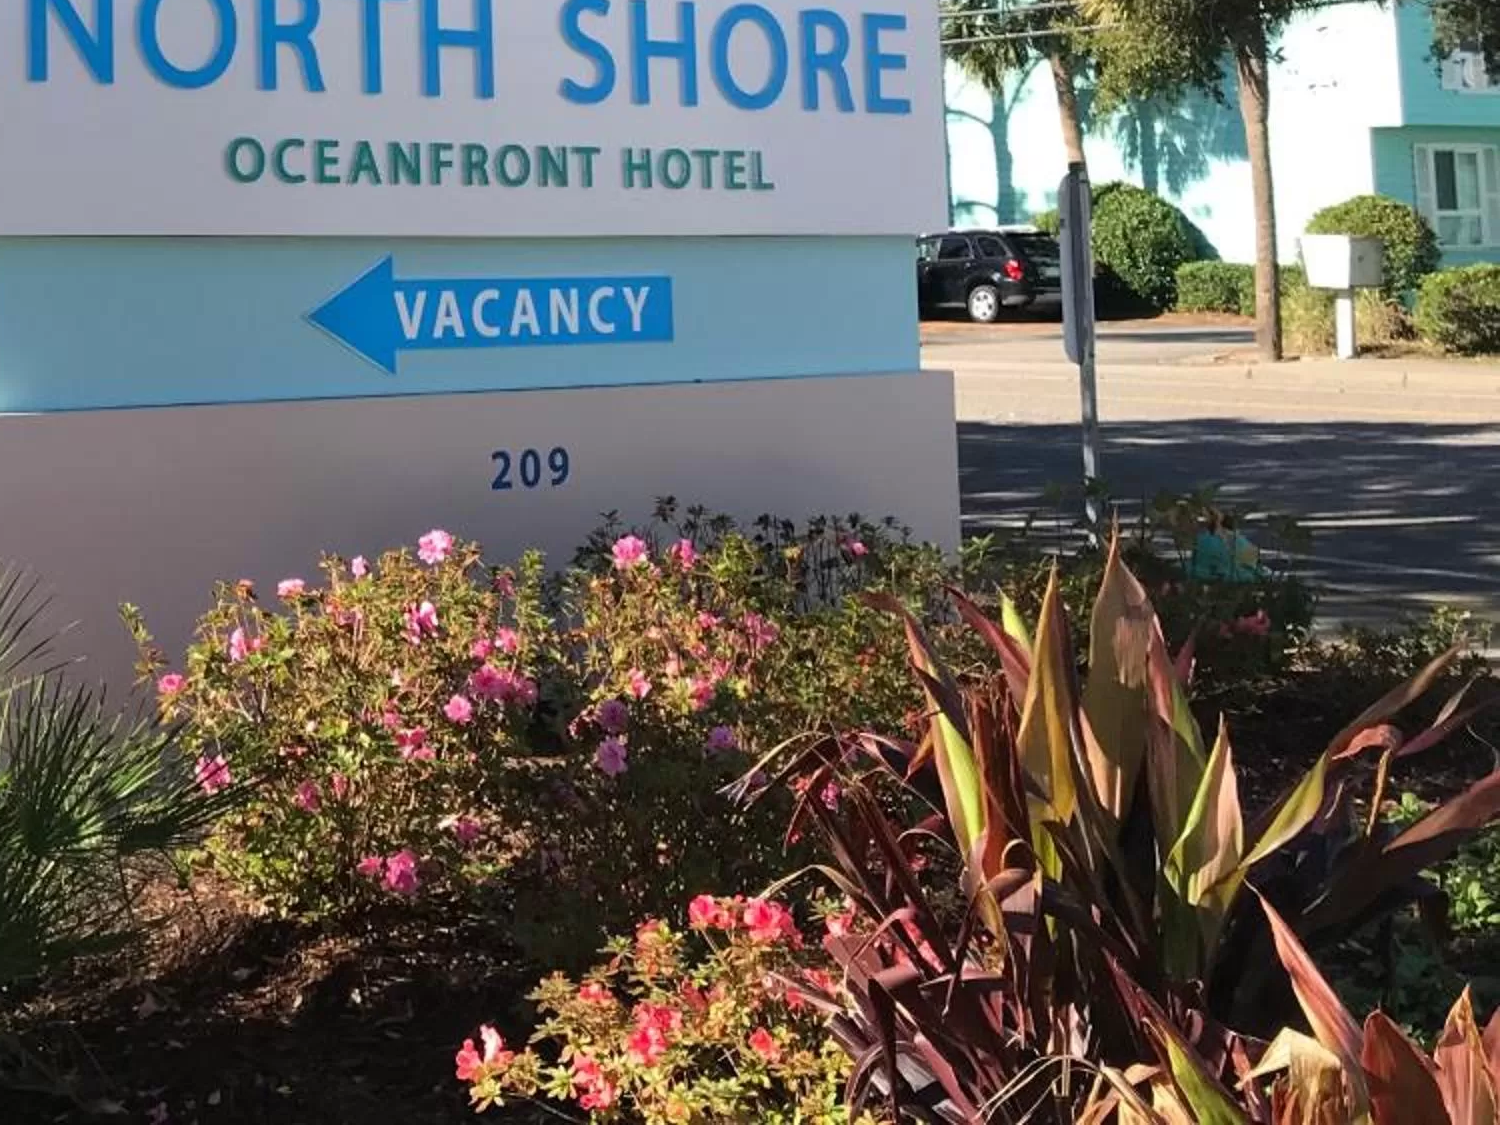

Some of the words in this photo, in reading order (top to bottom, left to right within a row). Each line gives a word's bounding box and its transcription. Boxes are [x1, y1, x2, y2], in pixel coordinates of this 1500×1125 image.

[225, 136, 601, 189] OCEANFRONT
[622, 147, 775, 191] HOTEL
[393, 286, 650, 340] VACANCY
[491, 446, 570, 491] 209
